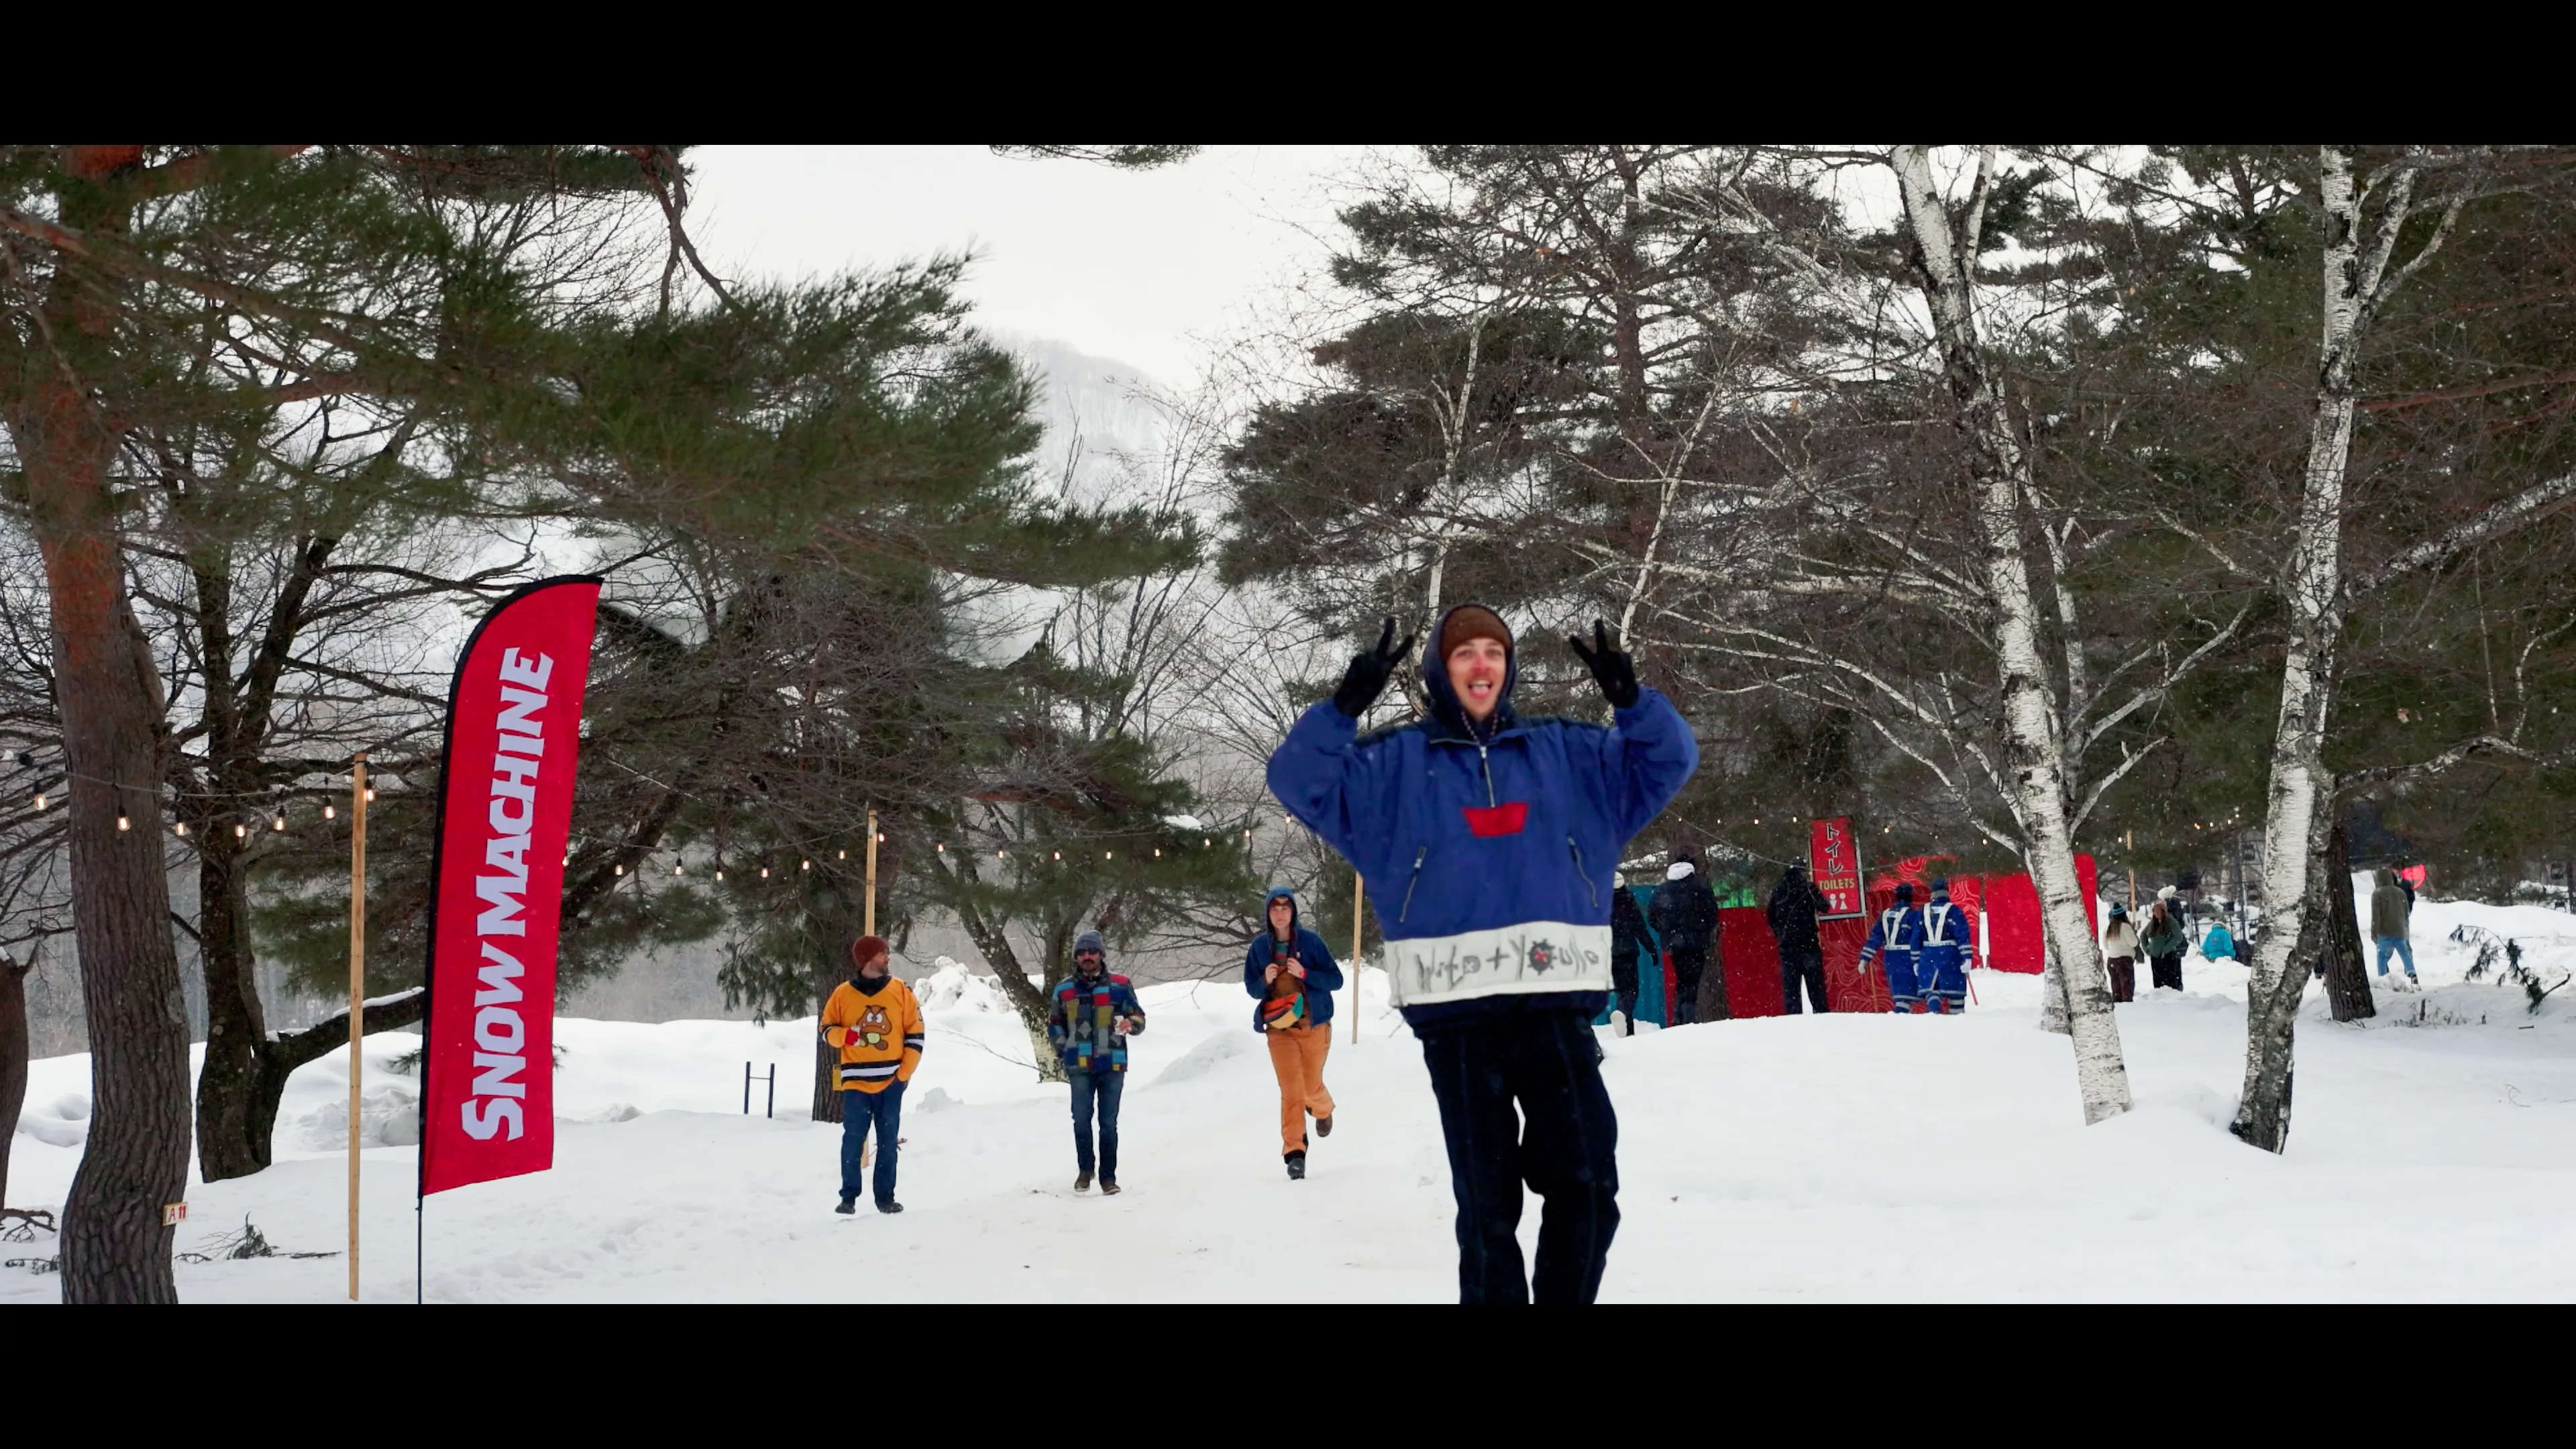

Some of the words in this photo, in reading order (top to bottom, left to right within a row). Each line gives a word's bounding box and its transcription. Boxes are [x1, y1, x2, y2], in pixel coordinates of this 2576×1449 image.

[476, 647, 553, 937] MACHINE
[1825, 822, 1843, 875] トイレ
[1818, 877, 1855, 891] TOILETS
[462, 941, 526, 1141] SNOW
